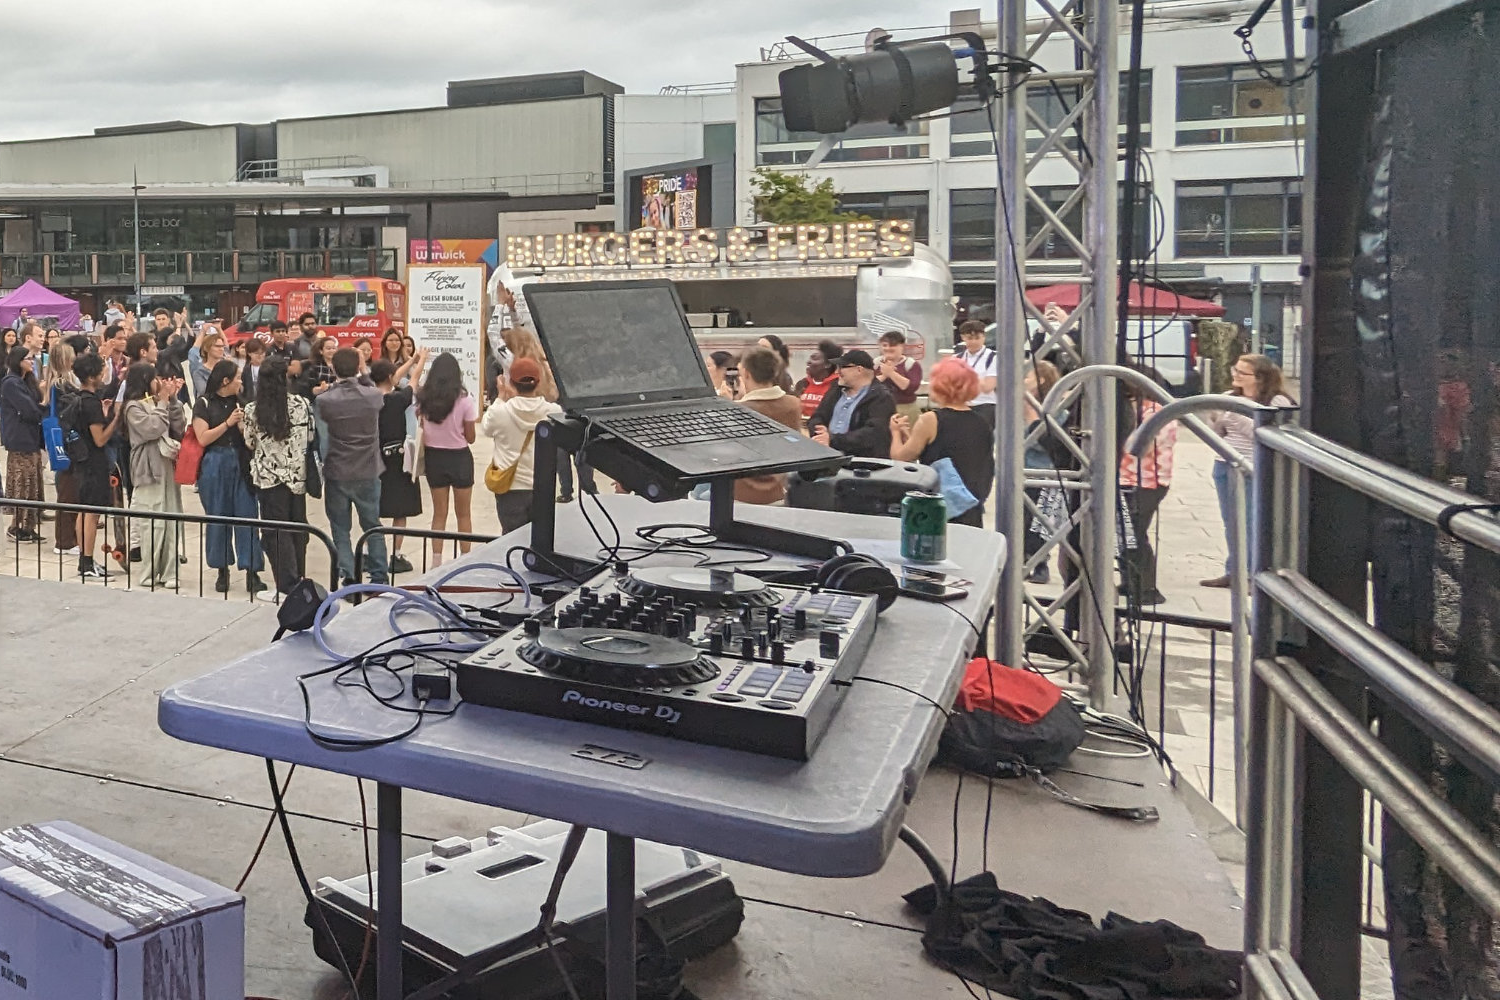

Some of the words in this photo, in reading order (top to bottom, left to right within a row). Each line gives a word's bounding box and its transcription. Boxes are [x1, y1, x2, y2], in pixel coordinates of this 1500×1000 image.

[659, 177, 682, 192] PRIDE
[121, 218, 160, 228] terace
[506, 229, 719, 268] BURGERS
[726, 227, 756, 263] &
[768, 220, 913, 261] FRIES
[415, 250, 466, 260] Wrwick
[424, 270, 460, 284] Flying
[561, 690, 652, 715] Pioneer
